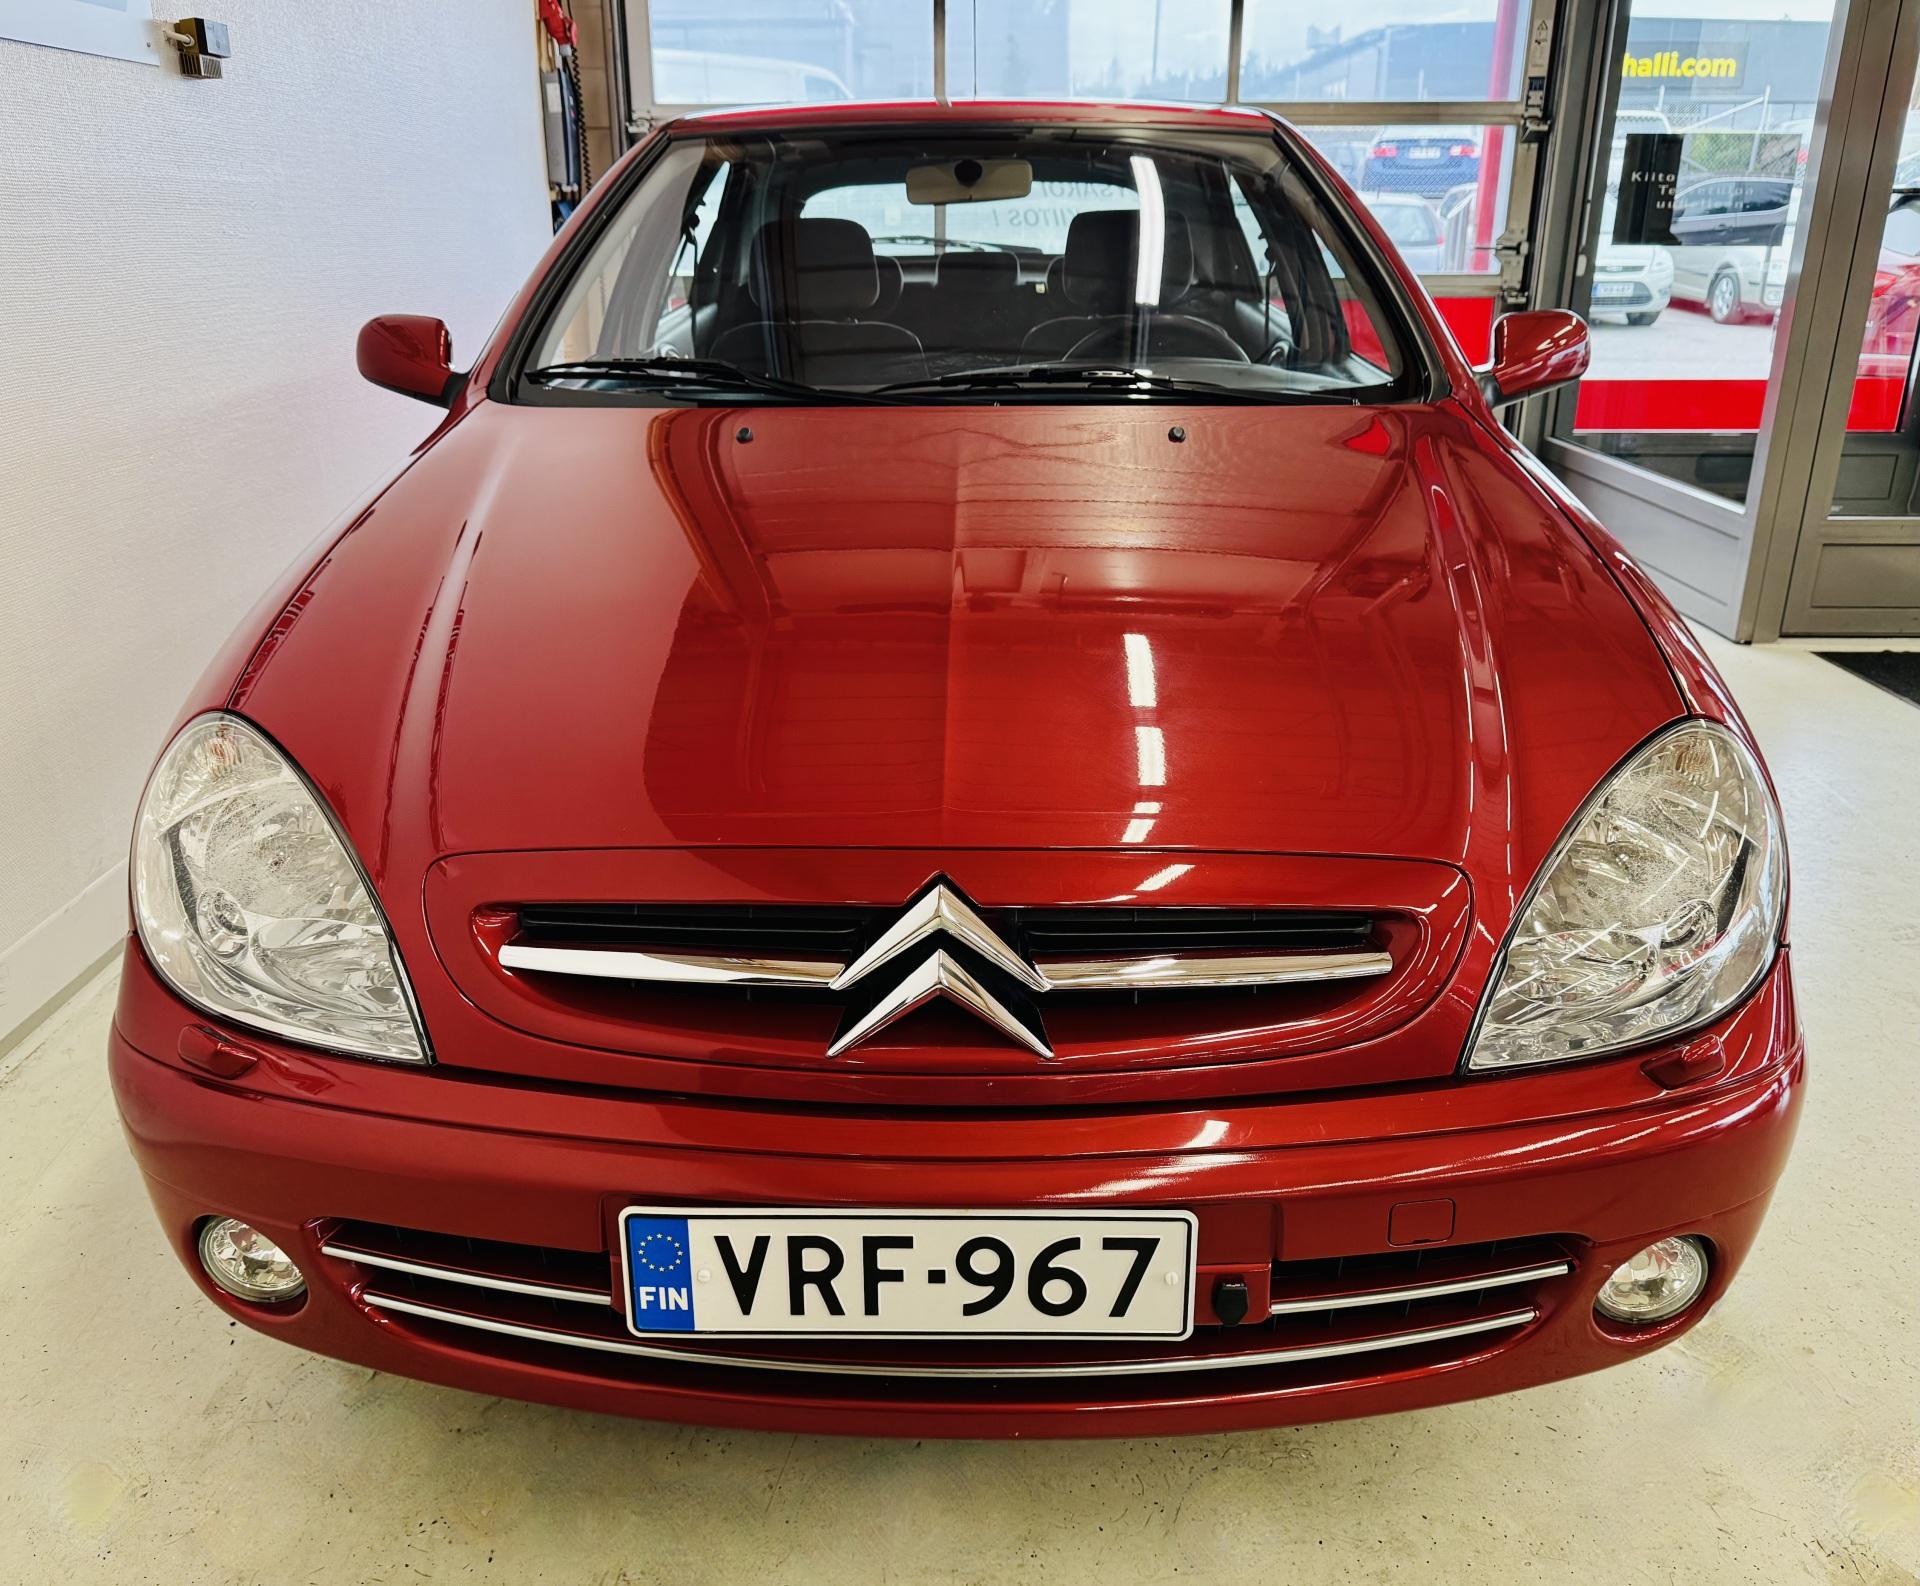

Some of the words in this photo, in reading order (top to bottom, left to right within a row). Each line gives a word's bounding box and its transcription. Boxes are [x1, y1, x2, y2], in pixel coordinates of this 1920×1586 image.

[1622, 51, 1737, 78] halli.com
[1631, 171, 1676, 183] Kiito
[713, 1234, 1162, 1318] VRF-967
[639, 1286, 689, 1311] FIN
